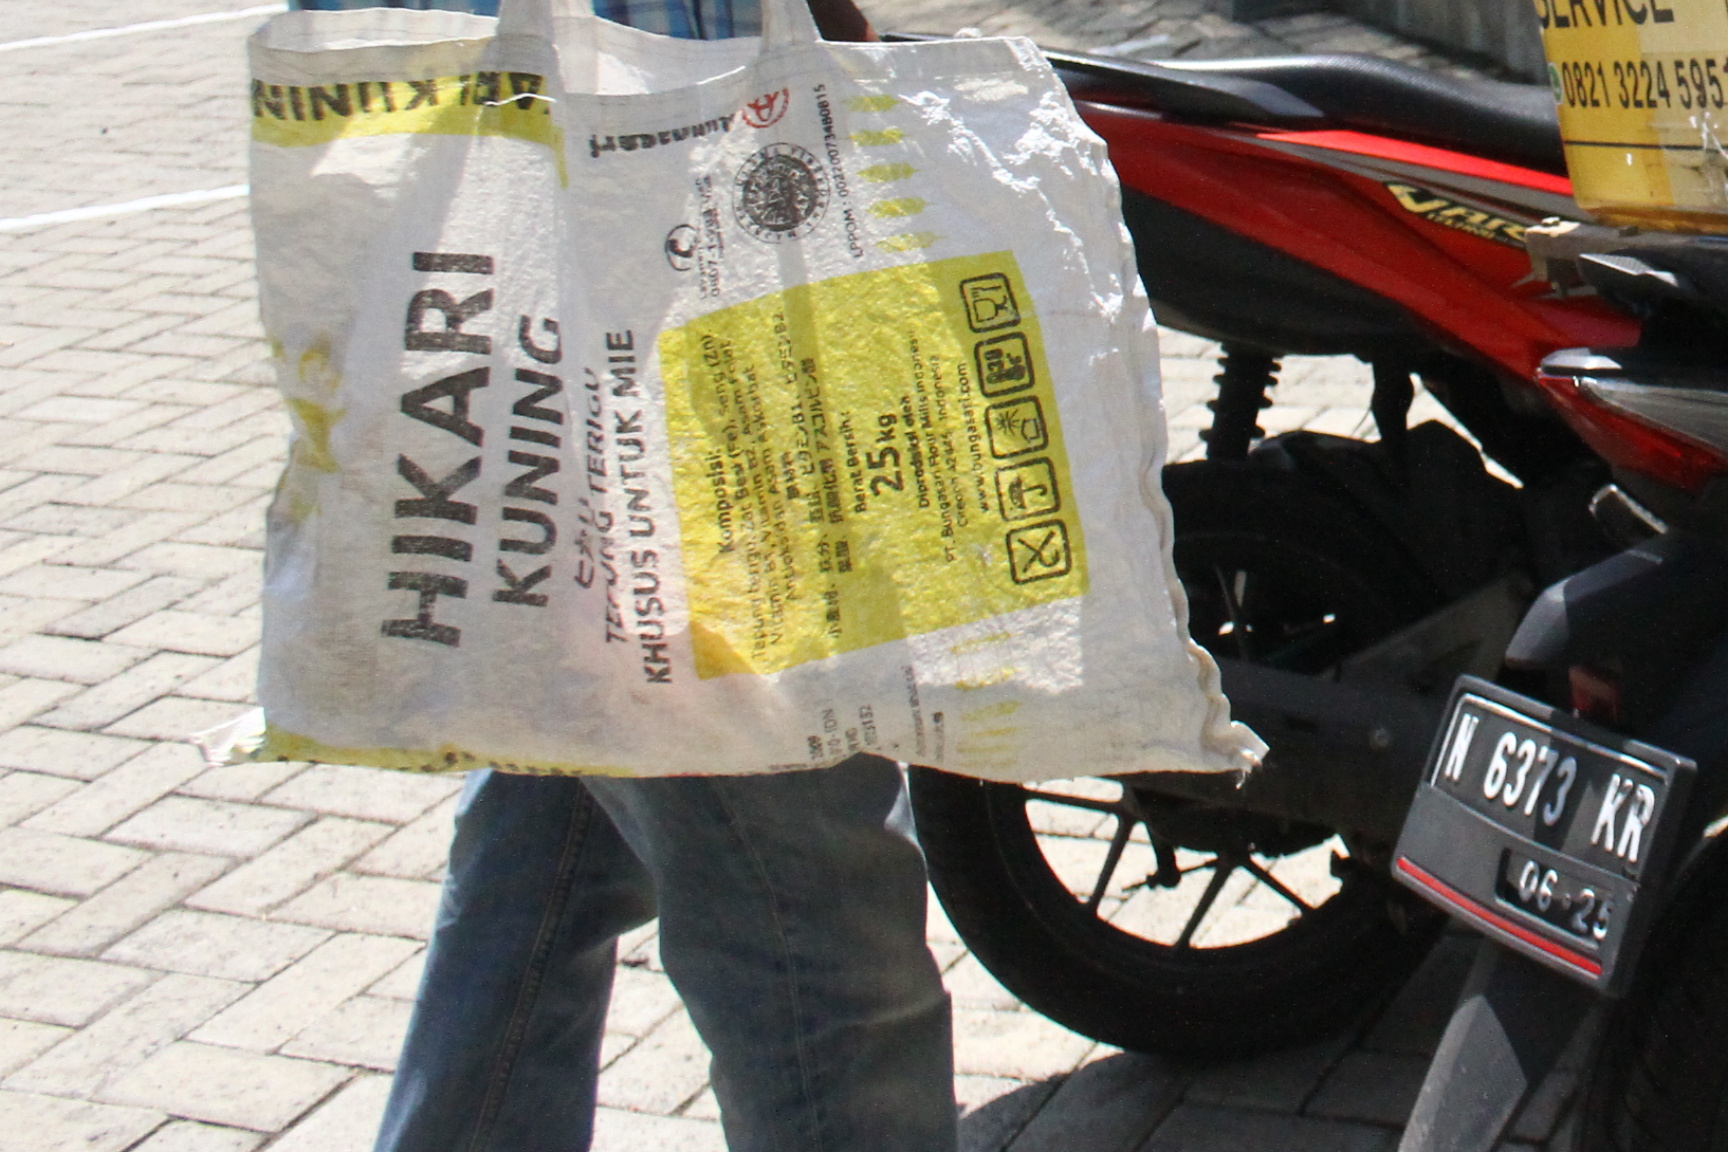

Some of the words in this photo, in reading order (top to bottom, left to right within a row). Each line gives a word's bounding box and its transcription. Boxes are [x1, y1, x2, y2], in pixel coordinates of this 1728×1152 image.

[252, 77, 439, 121] KUNIN
[1562, 61, 1611, 110] 0821
[1618, 61, 1671, 110] 3224
[842, 208, 864, 259] LPPOM
[605, 328, 640, 398] MIE
[379, 251, 496, 649] HIKARI
[491, 313, 566, 608] KUNING
[613, 410, 656, 538] UNTUK
[865, 446, 905, 498] 25
[875, 412, 898, 443] kg
[955, 362, 990, 514] www.bungasari.com
[629, 549, 673, 685] KHUSUS
[1445, 713, 1479, 781] N
[1483, 731, 1577, 827] 6373
[1590, 773, 1655, 863] KR
